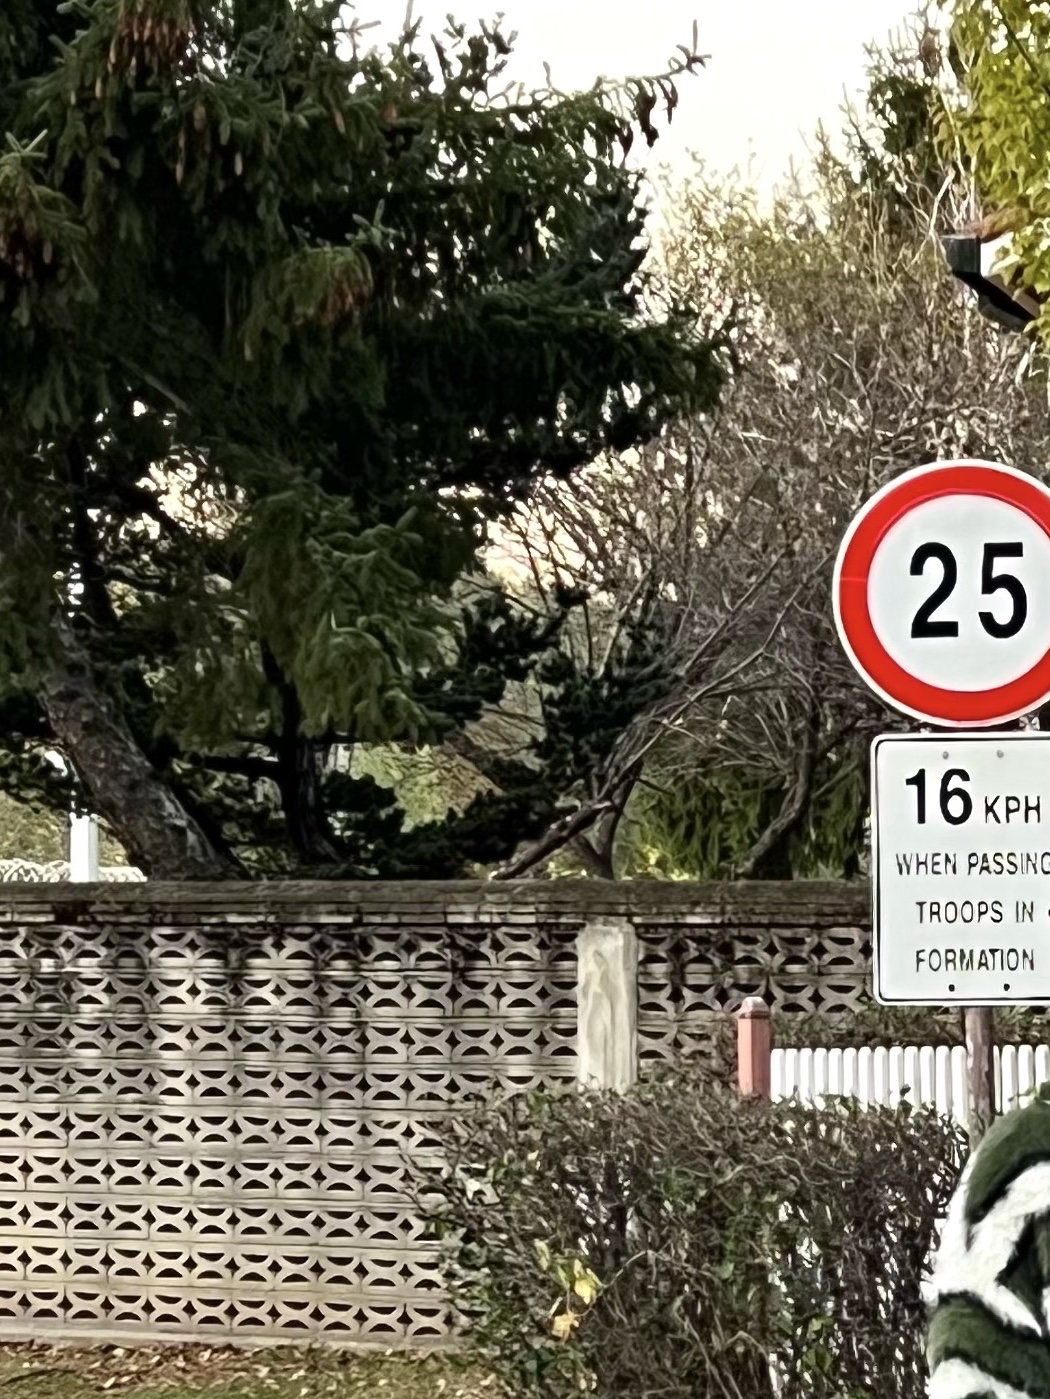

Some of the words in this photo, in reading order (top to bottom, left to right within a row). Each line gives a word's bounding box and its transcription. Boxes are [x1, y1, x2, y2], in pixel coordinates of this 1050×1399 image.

[909, 541, 1028, 639] 25
[905, 768, 973, 826] 16
[984, 795, 1041, 824] KPH
[895, 852, 957, 876] WHEN
[915, 900, 1003, 924] TROOPS
[1015, 900, 1034, 923] IN
[915, 948, 1035, 973] FORMATION
